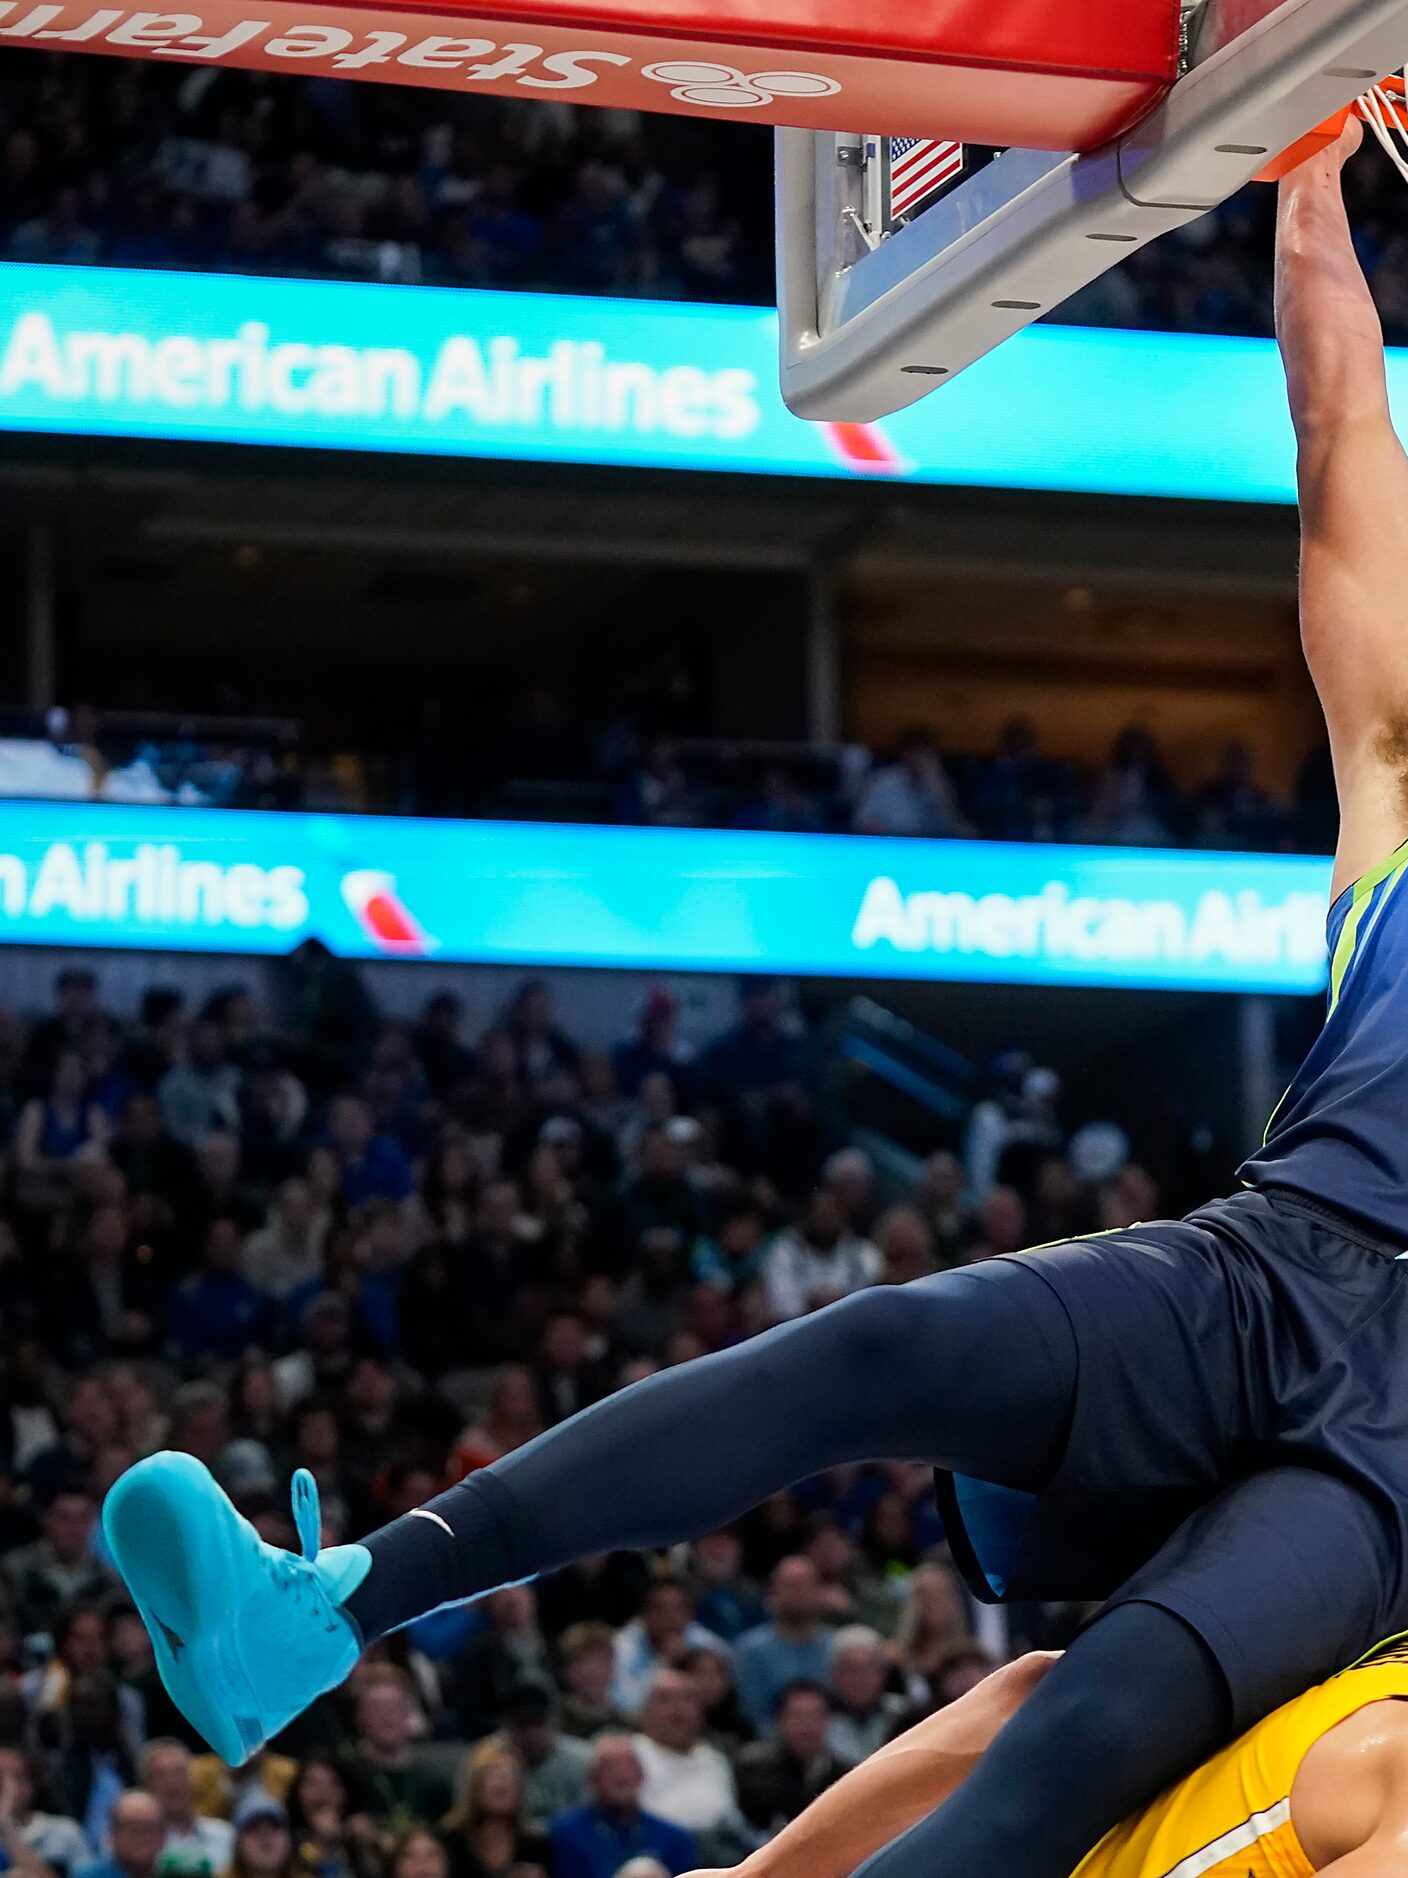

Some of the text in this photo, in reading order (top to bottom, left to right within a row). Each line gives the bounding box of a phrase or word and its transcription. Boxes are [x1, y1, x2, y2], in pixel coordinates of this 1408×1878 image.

[0, 311, 761, 440] American Airlines
[28, 839, 309, 932] Airlines
[851, 876, 1188, 960] American
